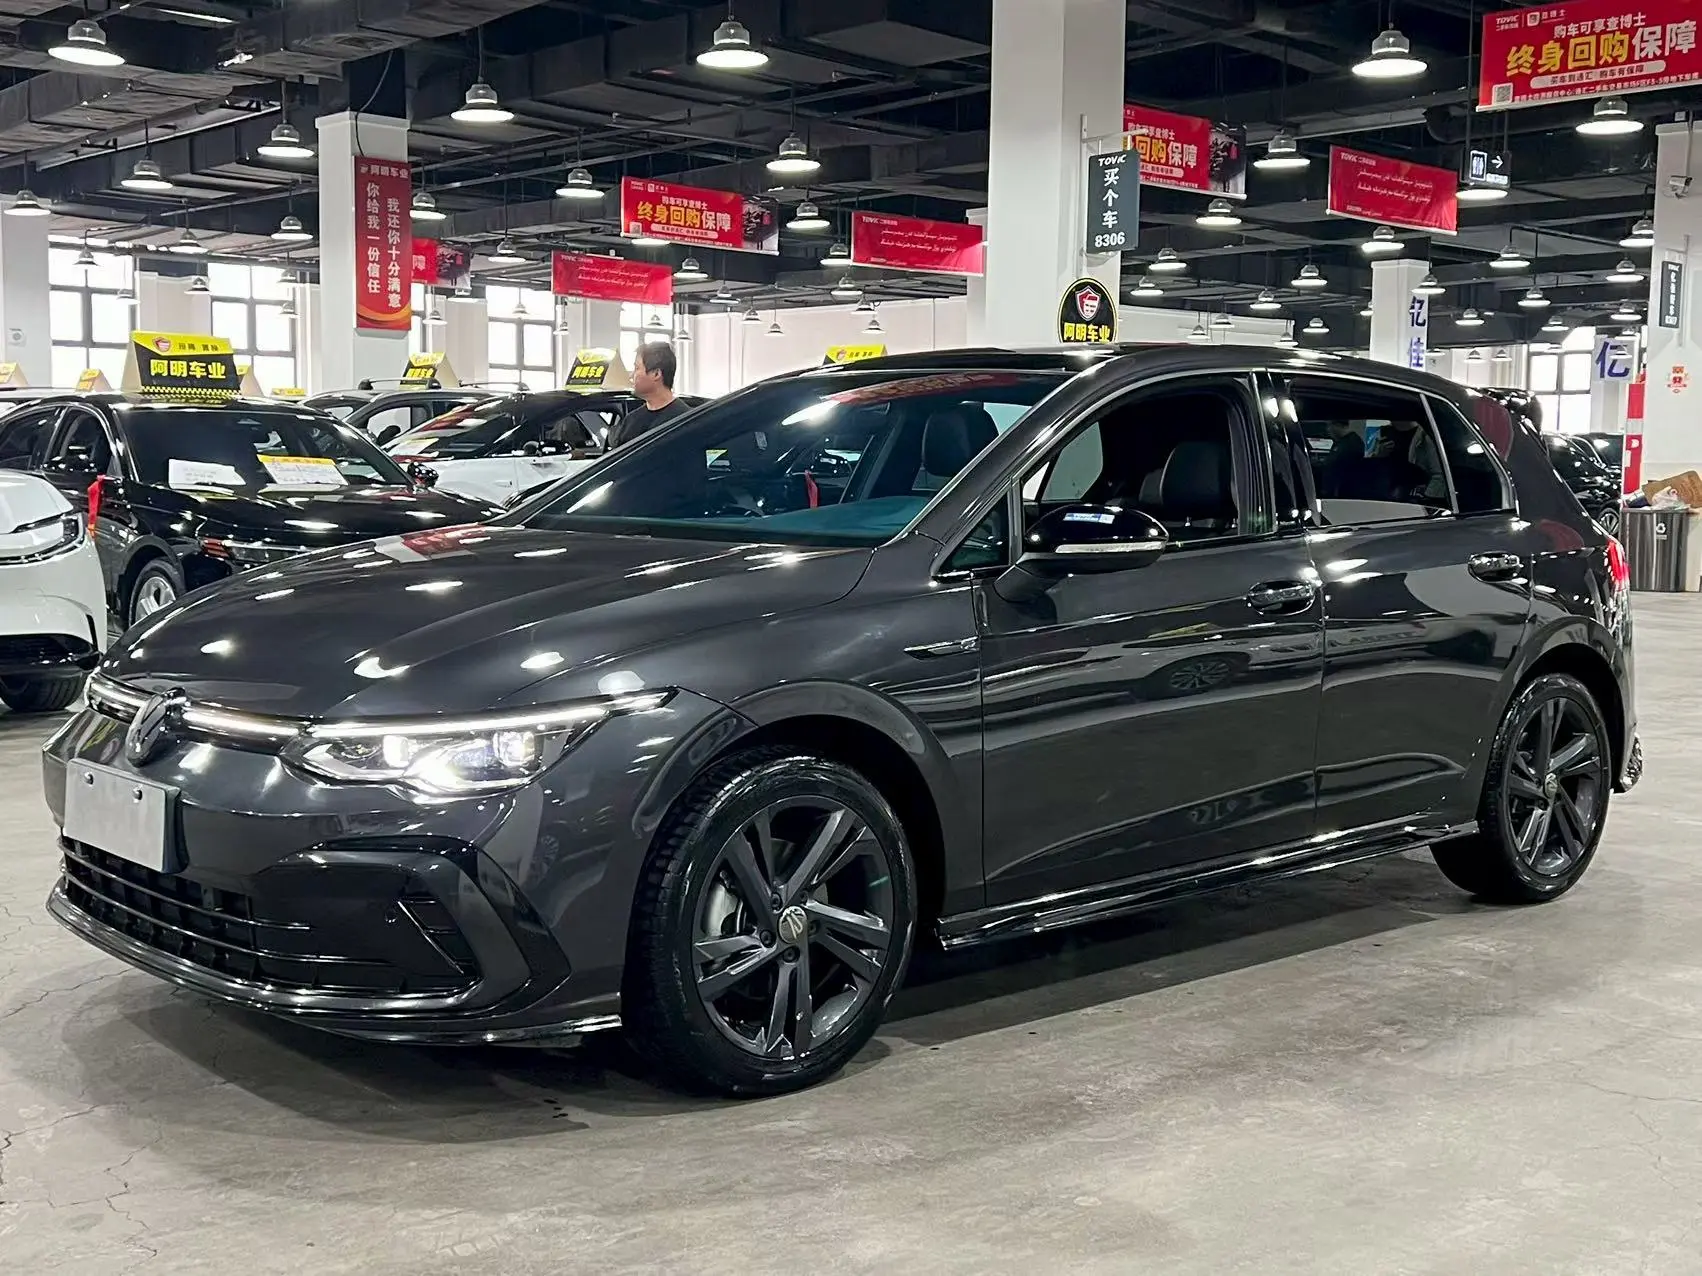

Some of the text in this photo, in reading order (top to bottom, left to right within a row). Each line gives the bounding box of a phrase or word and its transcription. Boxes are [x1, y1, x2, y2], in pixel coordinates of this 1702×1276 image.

[1554, 12, 1646, 38] 购车可享查博士
[1506, 20, 1697, 77] 终身回购保障
[1098, 154, 1127, 167] TOVIC
[1123, 135, 1198, 169] 回购保障
[370, 165, 409, 179] 阿明车业
[1102, 168, 1120, 229] 买个车
[637, 201, 732, 233] 终身回购保障
[366, 182, 381, 294] 你给我一份信任
[1094, 232, 1126, 248] 8306
[387, 198, 402, 309] 我还你十分满意
[1063, 322, 1111, 342] 阿明车业
[150, 359, 227, 379] 阿明车业
